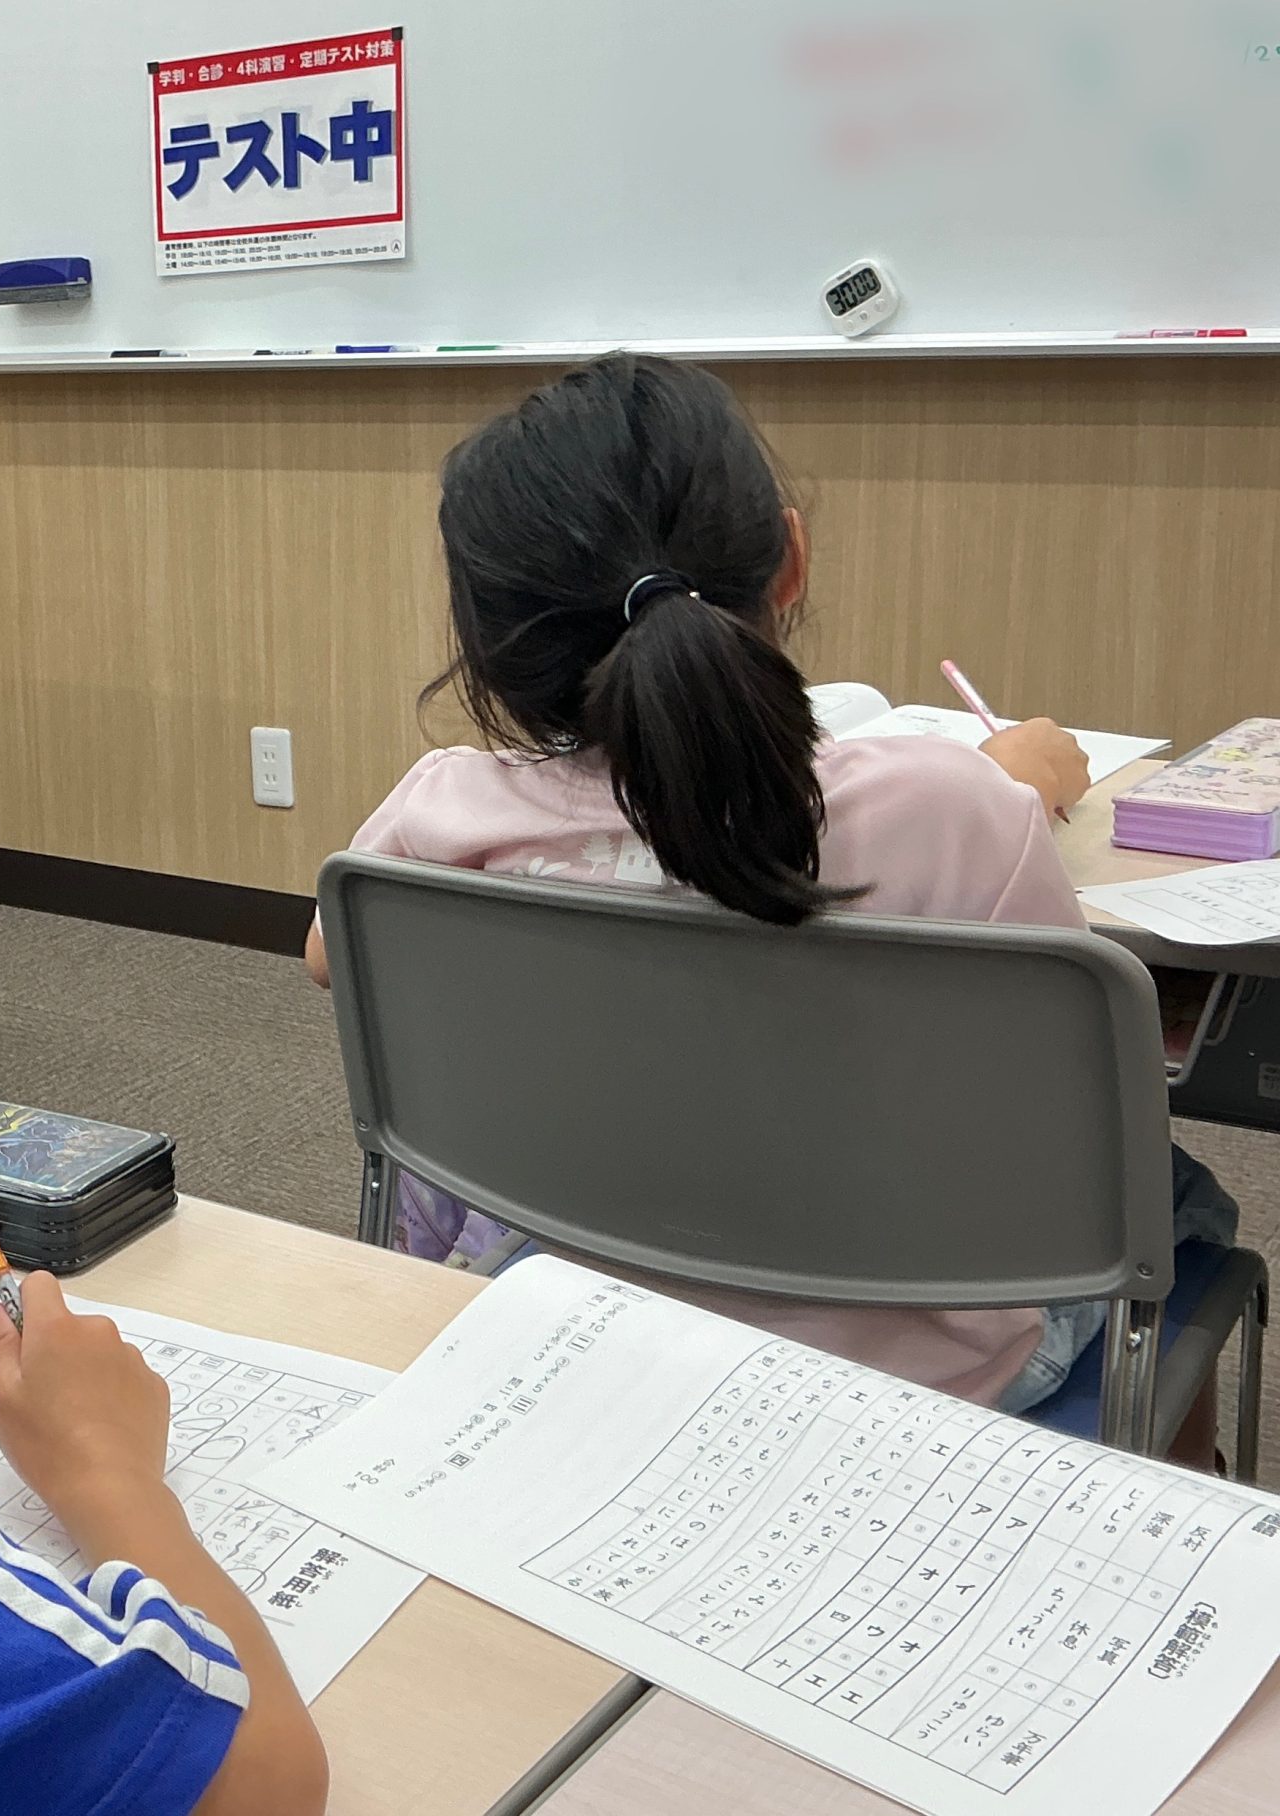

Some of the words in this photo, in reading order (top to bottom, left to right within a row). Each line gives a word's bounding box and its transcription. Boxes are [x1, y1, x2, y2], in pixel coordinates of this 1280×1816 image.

[163, 100, 393, 201] テスト中
[848, 1390, 868, 1404] エ
[929, 1443, 951, 1457] エ
[1021, 1447, 1041, 1458] イ
[1056, 1459, 1076, 1472] ウ
[1066, 1479, 1108, 1515] どうわ
[970, 1503, 992, 1516] ア
[1103, 1488, 1145, 1535] じょしゅ
[869, 1518, 888, 1532] ウ
[1005, 1516, 1028, 1530] ア
[1142, 1509, 1175, 1539] 深海
[1180, 1525, 1211, 1552] 反対
[268, 1547, 342, 1609] 解答用紙
[918, 1567, 940, 1581] オ
[956, 1583, 976, 1596] イ
[1008, 1586, 1065, 1650] ちょうれい
[867, 1624, 886, 1638] ウ
[1061, 1619, 1090, 1650] 休息
[1147, 1601, 1217, 1680] 〔模範解答〕
[899, 1640, 921, 1653] オ
[1097, 1635, 1131, 1665] 写真
[804, 1674, 827, 1688] エ
[841, 1691, 863, 1705] エ
[918, 1687, 977, 1740] りゅうこう
[964, 1713, 1005, 1748] ゆらい
[1001, 1729, 1047, 1767] 万年筆
